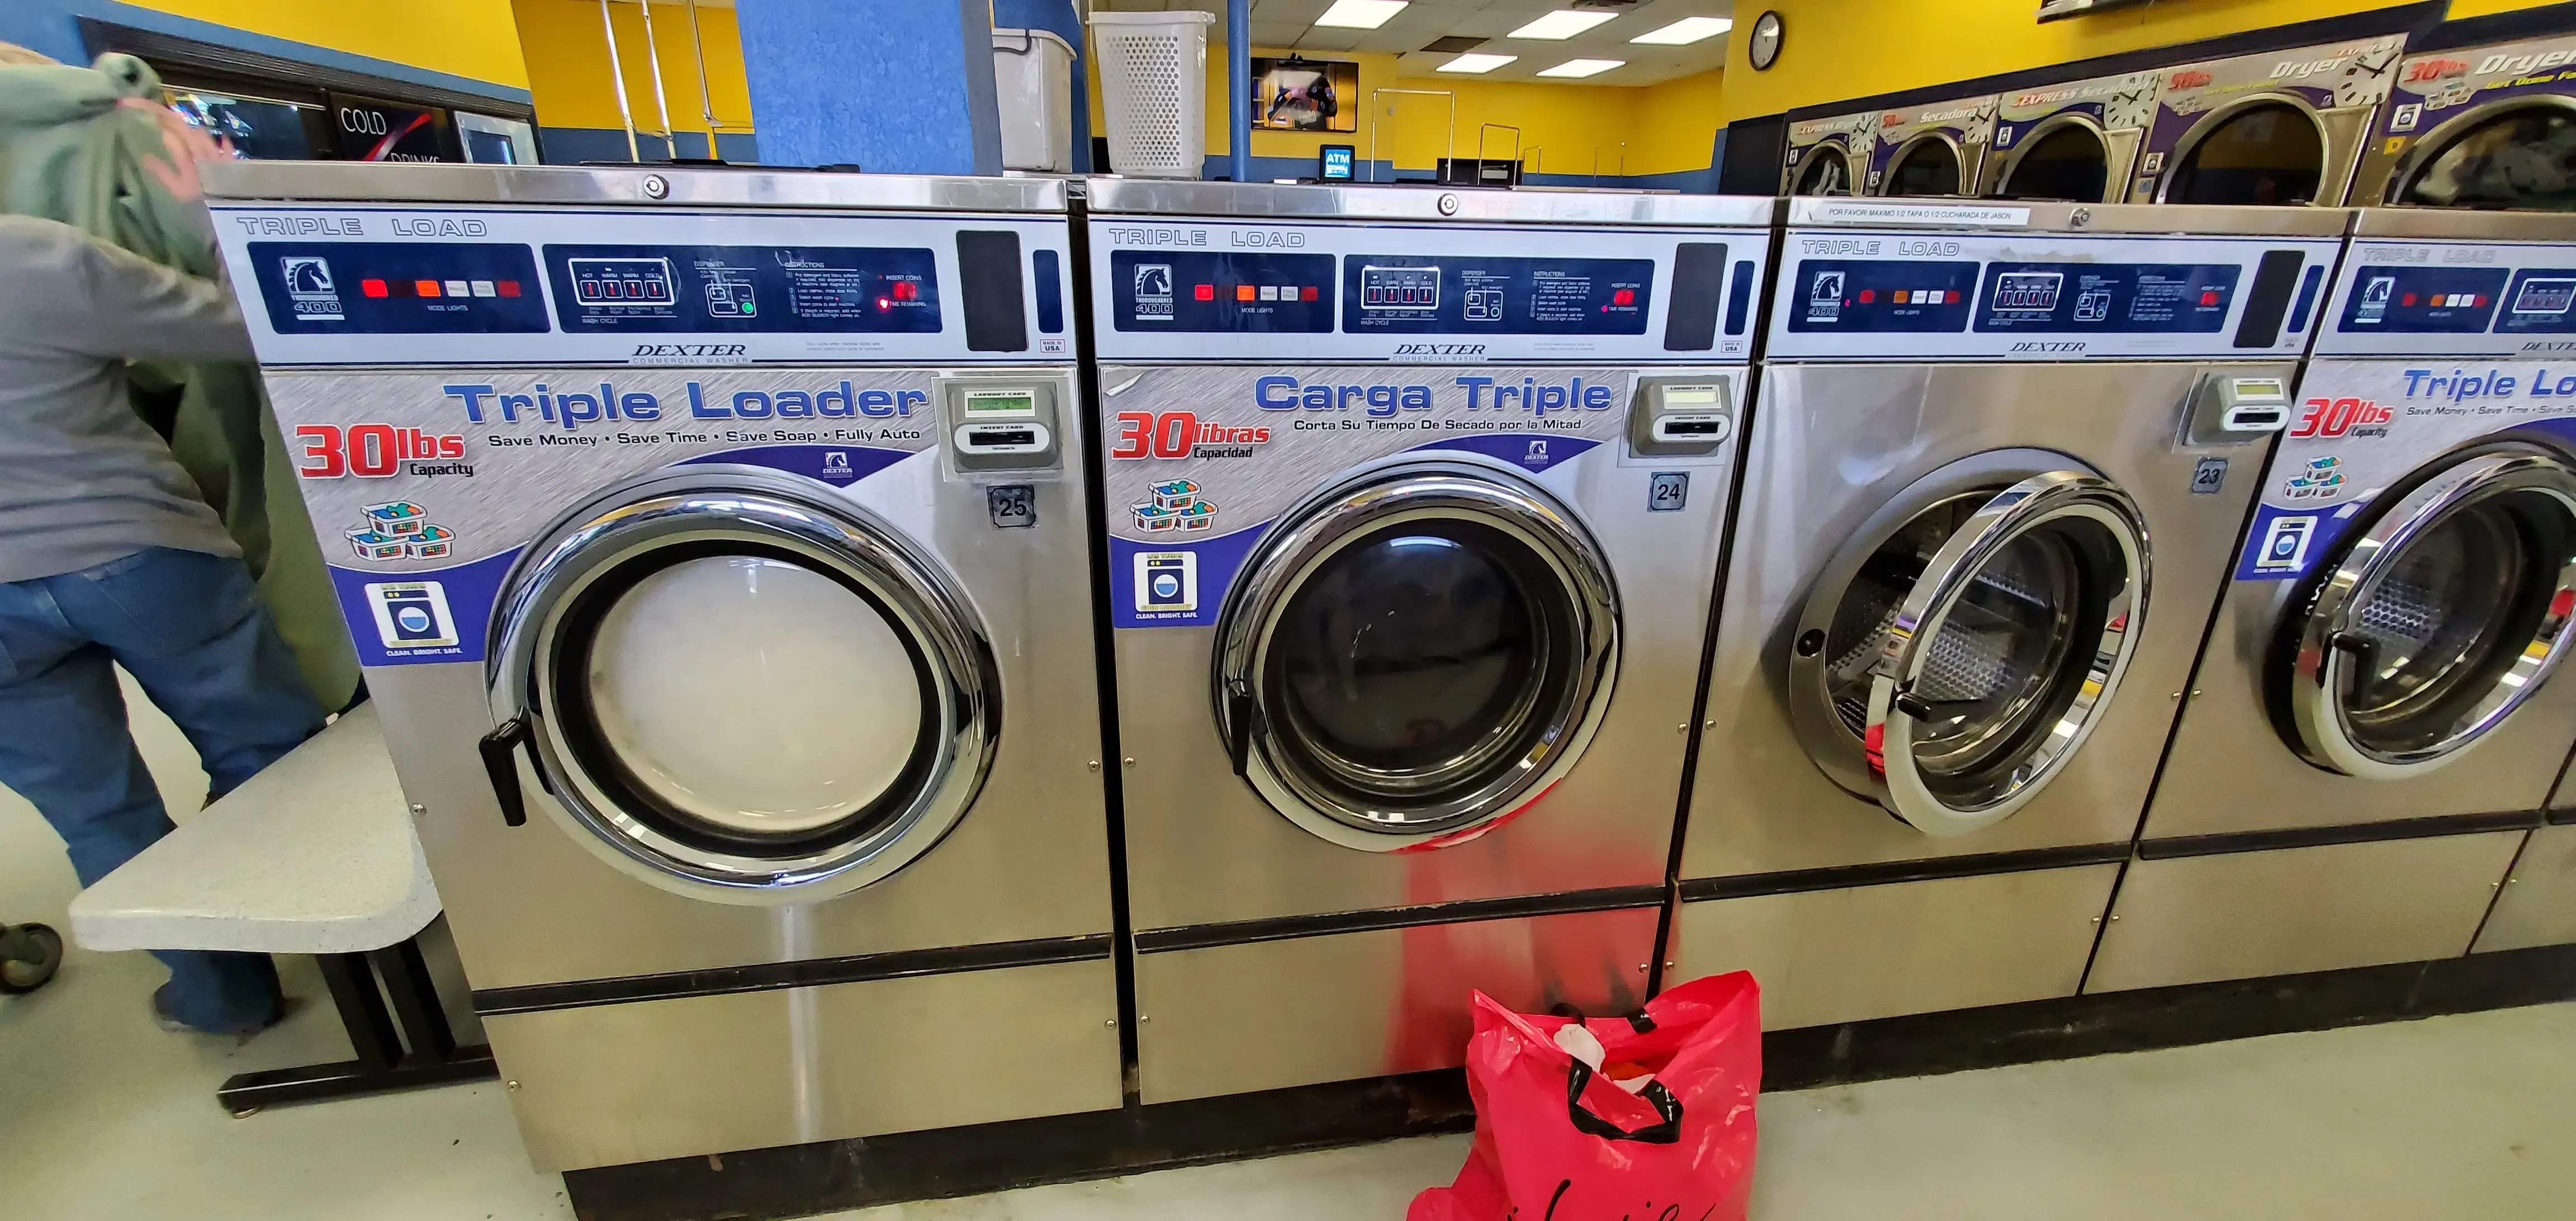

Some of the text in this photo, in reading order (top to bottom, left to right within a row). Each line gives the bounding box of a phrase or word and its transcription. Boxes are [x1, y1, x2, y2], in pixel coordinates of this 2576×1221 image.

[2270, 56, 2348, 79] Dryer
[339, 107, 387, 136] COLD
[1920, 107, 1978, 123] Secadora
[1326, 153, 1349, 164] ATM
[236, 217, 487, 236] TRIPLE LOAD
[1109, 228, 1305, 248] TRIPLE LOAD
[1802, 240, 1960, 257] TRIPLE LOAD
[2364, 248, 2497, 263] TRIPLE LOAD
[293, 301, 343, 314] 400
[1135, 304, 1173, 314] 400
[1808, 306, 1839, 316] 400
[631, 344, 746, 357] DEXTER
[1393, 344, 1486, 354] DEXTER
[2009, 342, 2086, 352] DEXTER
[2404, 368, 2516, 403] Triple
[1255, 375, 1613, 418] Carga Triple
[442, 380, 929, 430] Triple Loader
[2407, 406, 2431, 415] Save
[2434, 406, 2467, 417] Money
[2478, 406, 2502, 415] Save
[1294, 419, 1581, 432] Corta Su Tiempo De Secado por la Mitad
[2351, 427, 2388, 438] Capacity
[489, 429, 920, 448] Save Money Save Time Save Soap Fully Auto
[1194, 447, 1253, 461] Capacidad
[410, 463, 474, 479] Capacity
[2199, 468, 2221, 485] 23
[1657, 483, 1680, 500] 24
[998, 498, 1027, 517] 25
